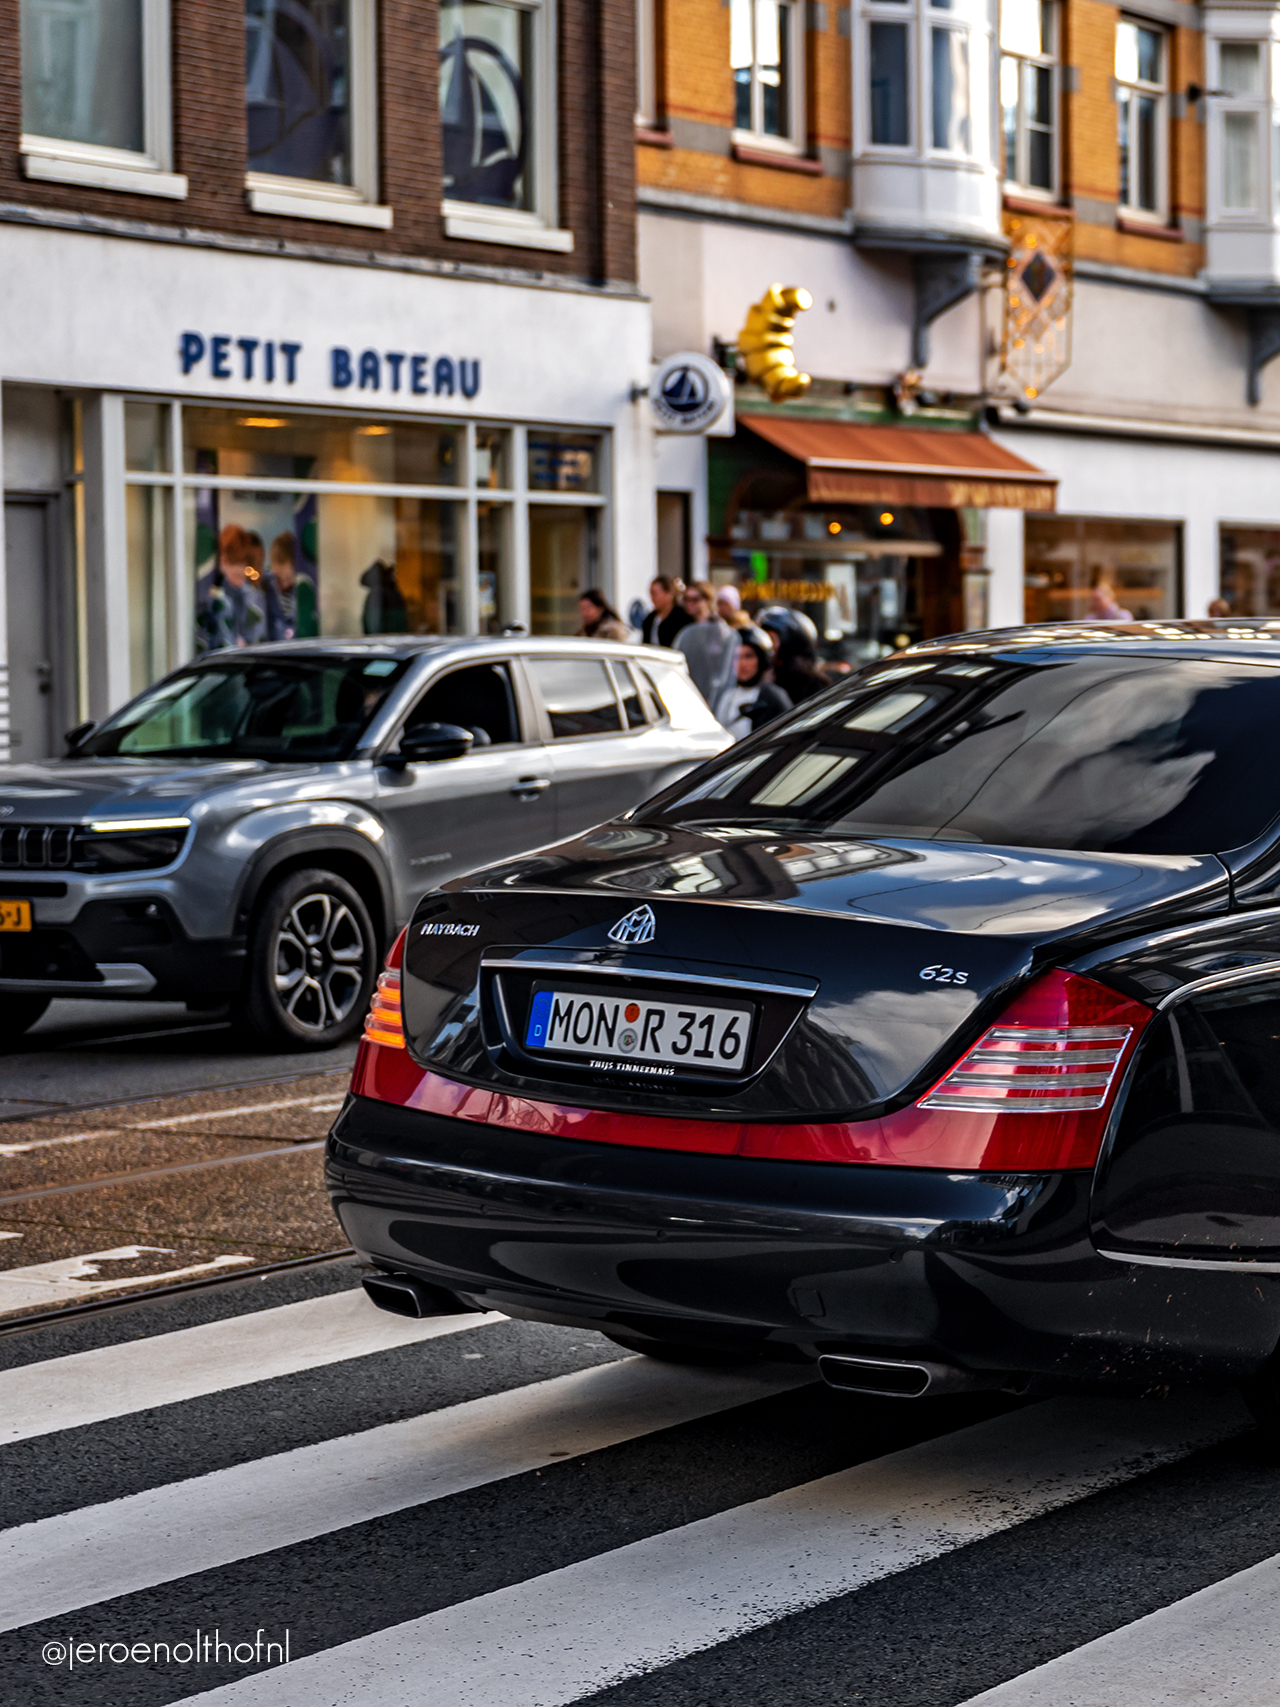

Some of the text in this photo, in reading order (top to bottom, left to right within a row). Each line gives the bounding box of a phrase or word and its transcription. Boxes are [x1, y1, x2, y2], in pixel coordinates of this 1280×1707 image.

[180, 331, 480, 399] PETIT BATEAU
[420, 923, 481, 936] MAYBACH
[534, 998, 742, 1060] D MON R 316
